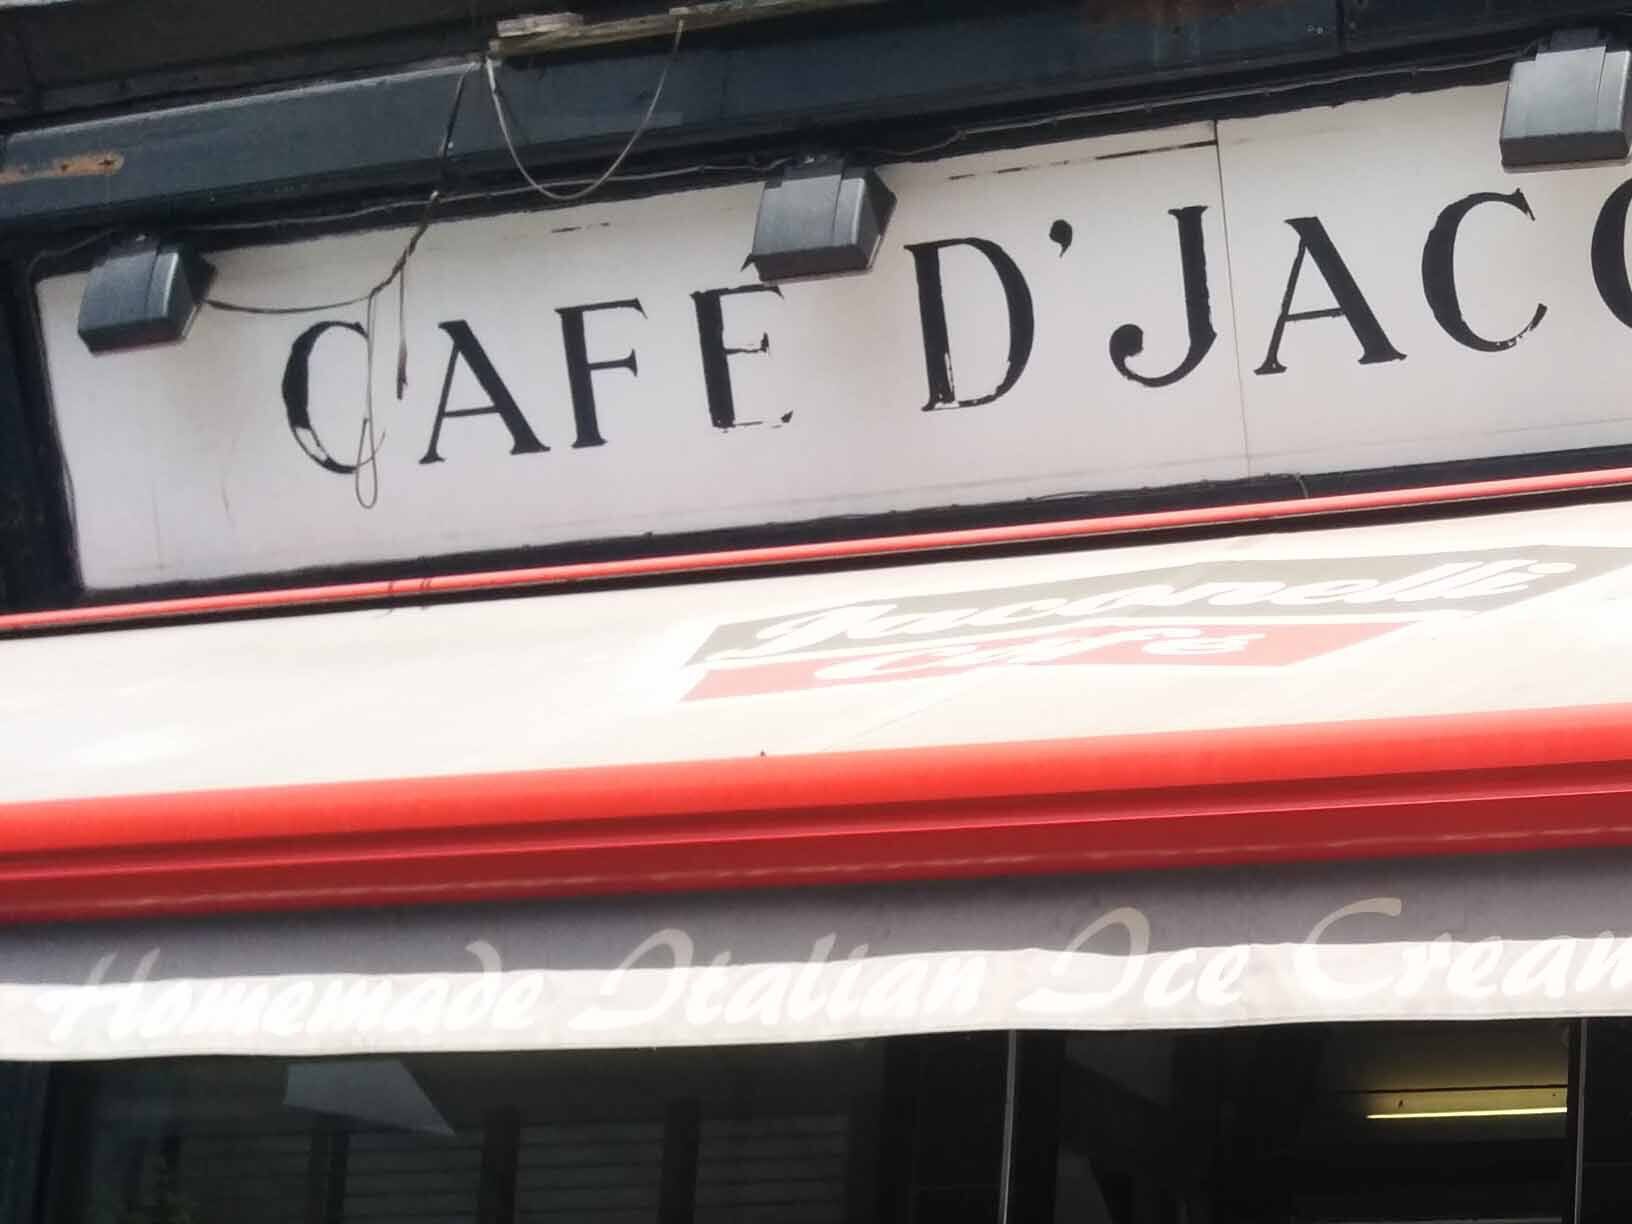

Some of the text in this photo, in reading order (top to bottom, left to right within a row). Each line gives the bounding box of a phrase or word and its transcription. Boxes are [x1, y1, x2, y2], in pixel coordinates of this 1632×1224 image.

[34, 940, 544, 1040] Homemade
[568, 928, 988, 1031] Italian
[1016, 907, 1244, 1013] Ice
